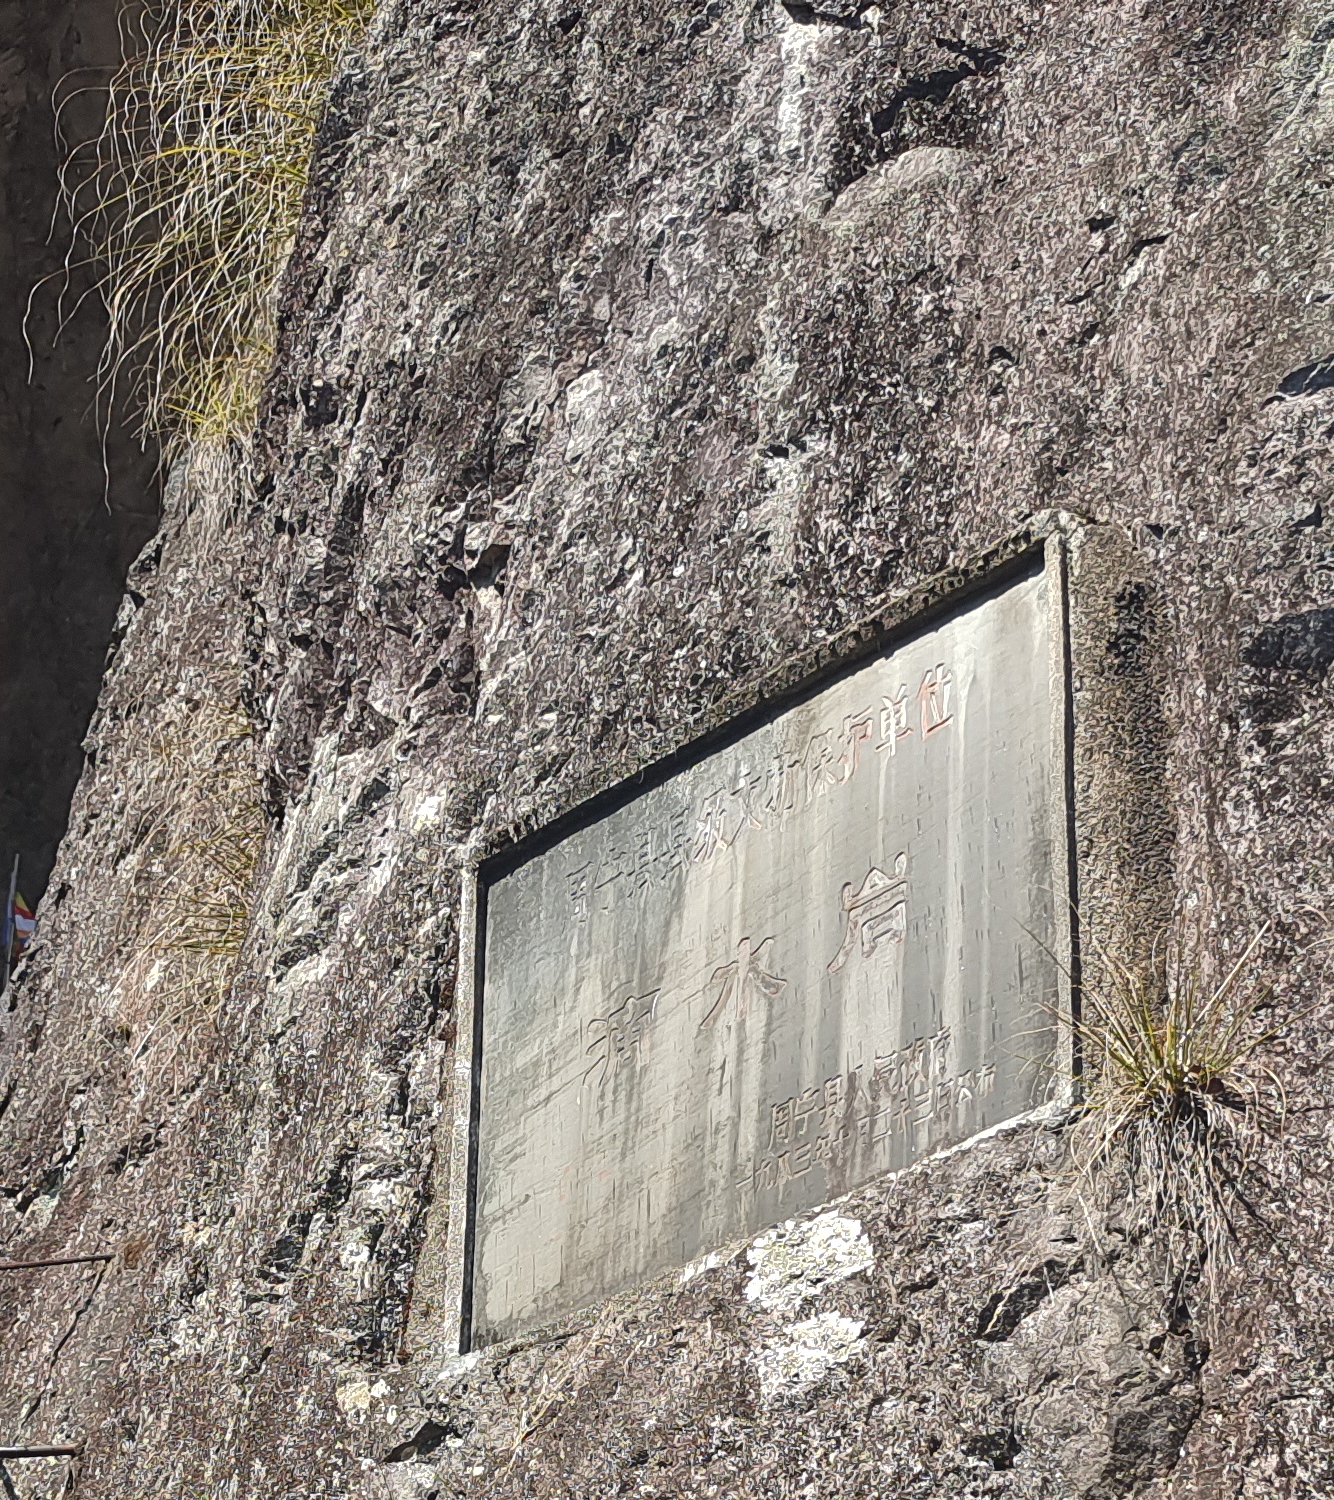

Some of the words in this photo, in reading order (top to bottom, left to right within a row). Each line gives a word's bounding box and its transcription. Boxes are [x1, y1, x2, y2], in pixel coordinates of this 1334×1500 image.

[580, 850, 910, 1088] 滴水岩
[766, 1024, 952, 1152] 周宁县人民政府
